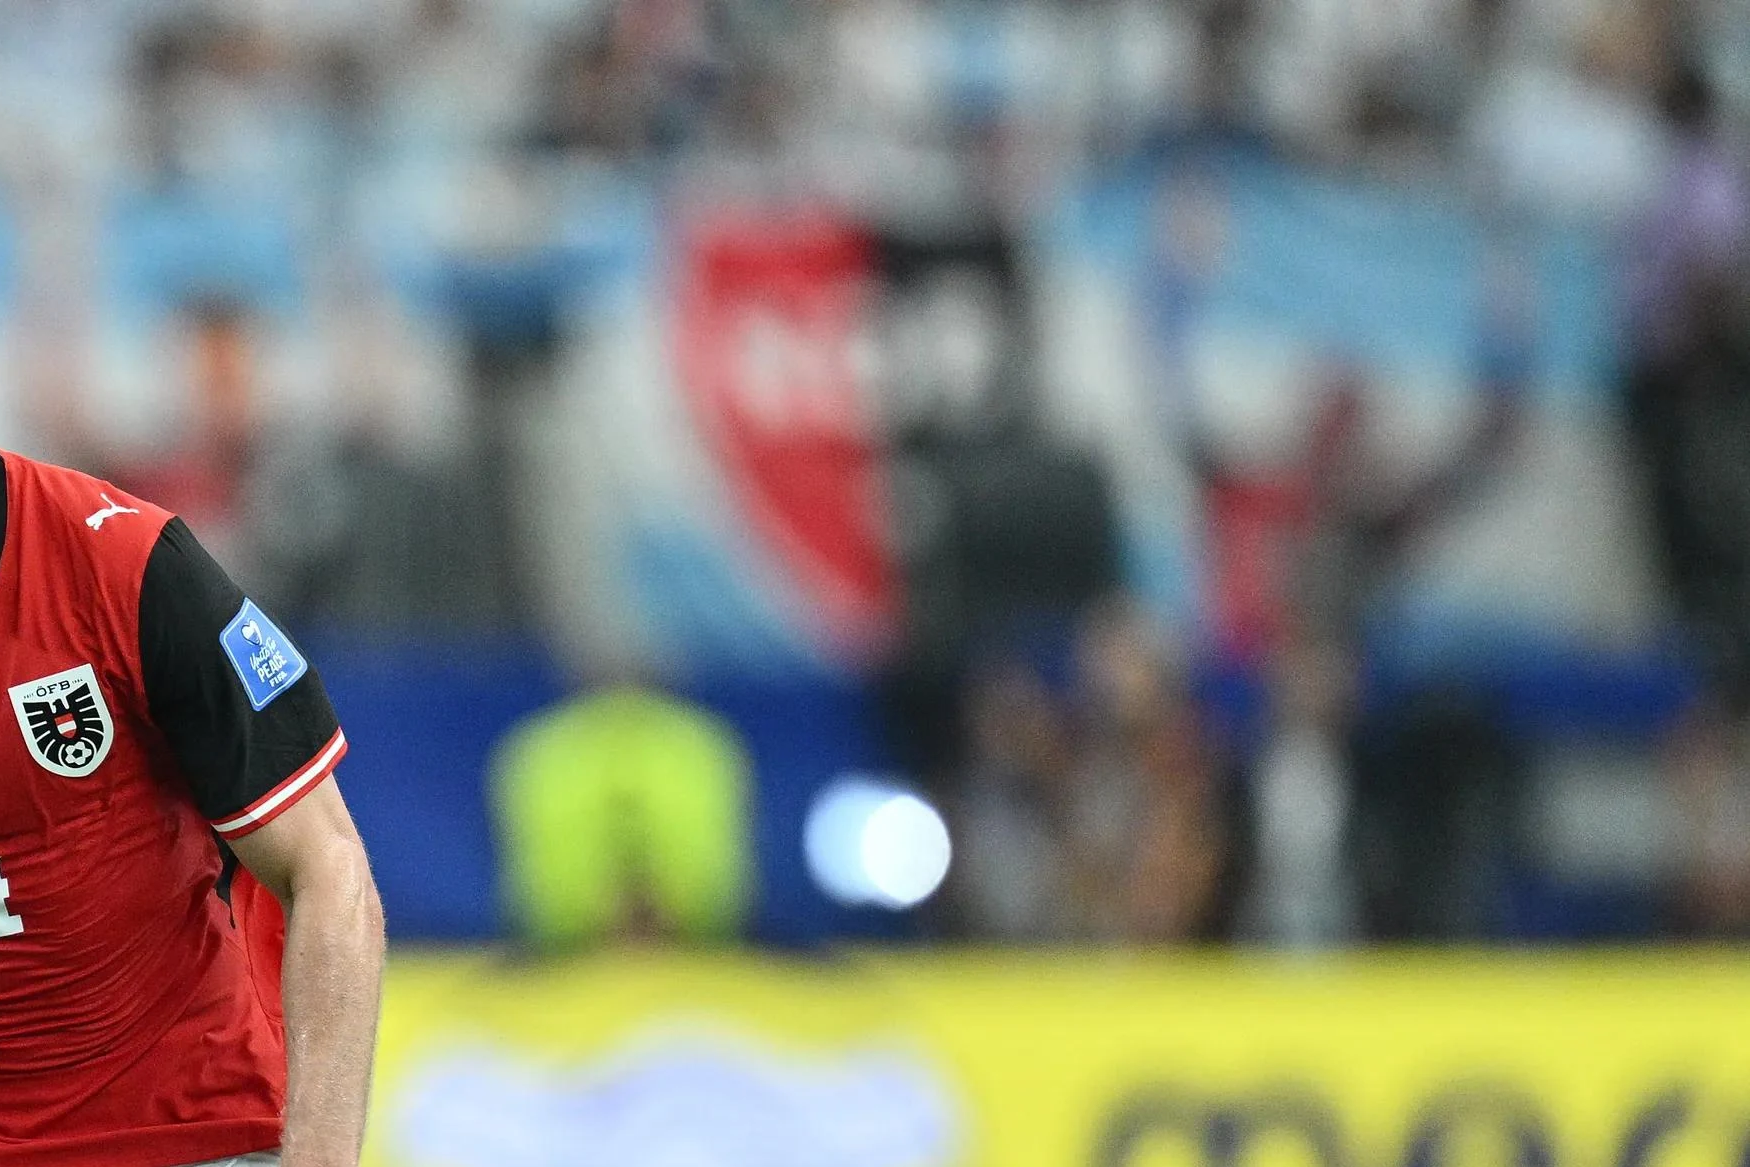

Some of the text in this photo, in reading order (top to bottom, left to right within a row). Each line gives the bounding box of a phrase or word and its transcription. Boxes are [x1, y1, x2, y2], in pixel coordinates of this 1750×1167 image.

[257, 650, 287, 683] PEACE
[269, 671, 288, 687] FIFA
[36, 680, 70, 697] ÖFB
